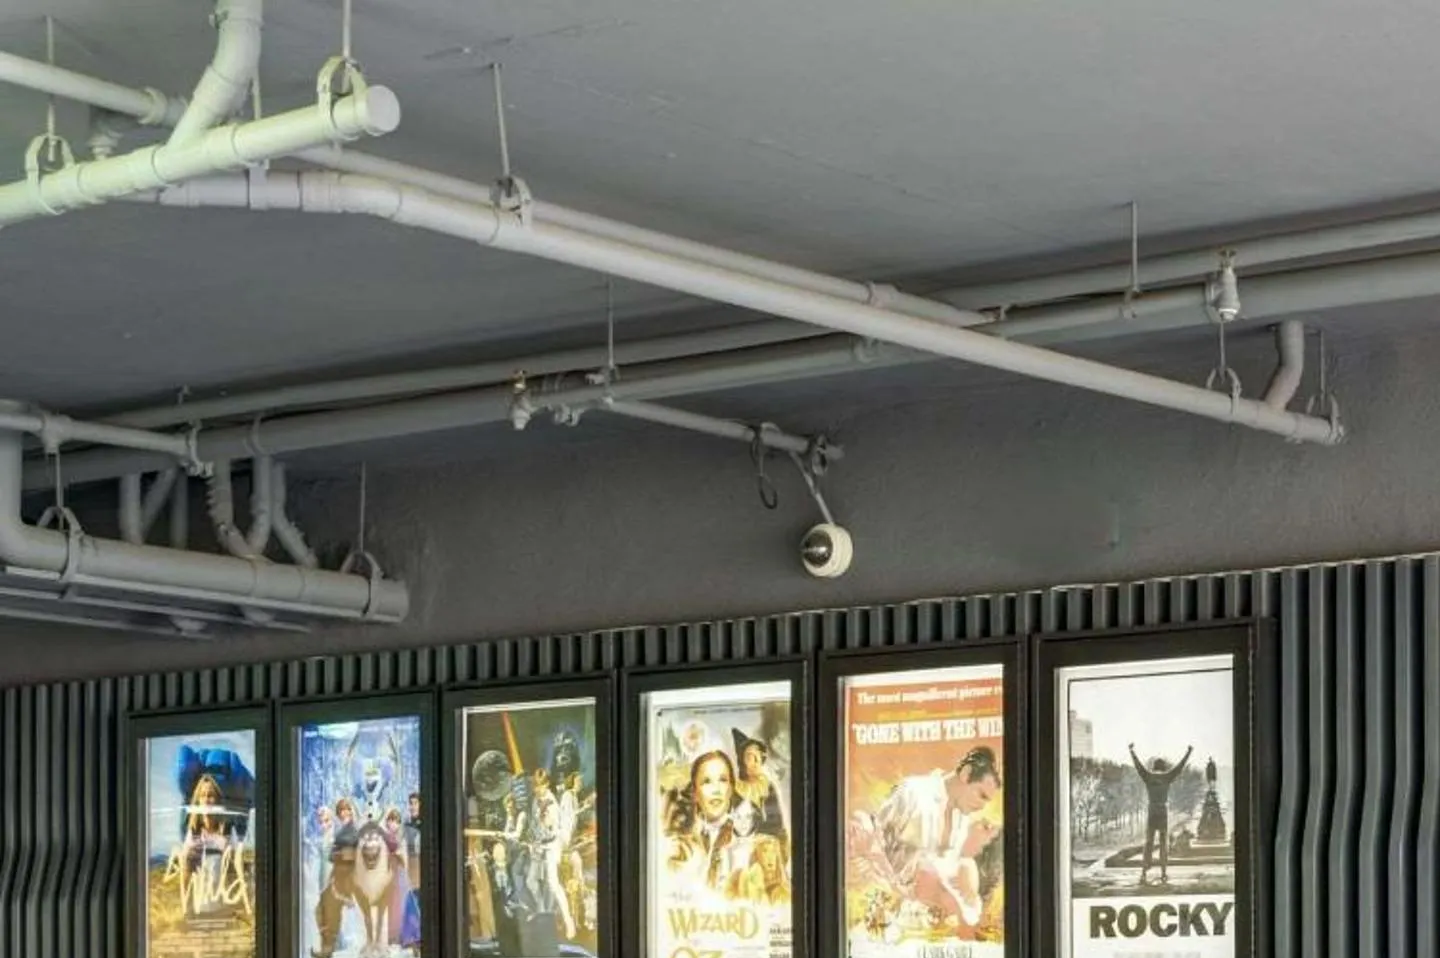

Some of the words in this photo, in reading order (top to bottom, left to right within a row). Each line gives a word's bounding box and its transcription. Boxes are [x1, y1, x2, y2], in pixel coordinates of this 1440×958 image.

[901, 720, 942, 743] WITH
[943, 718, 977, 741] THE
[667, 906, 760, 940] WIZARD
[1090, 902, 1233, 939] ROCKY
